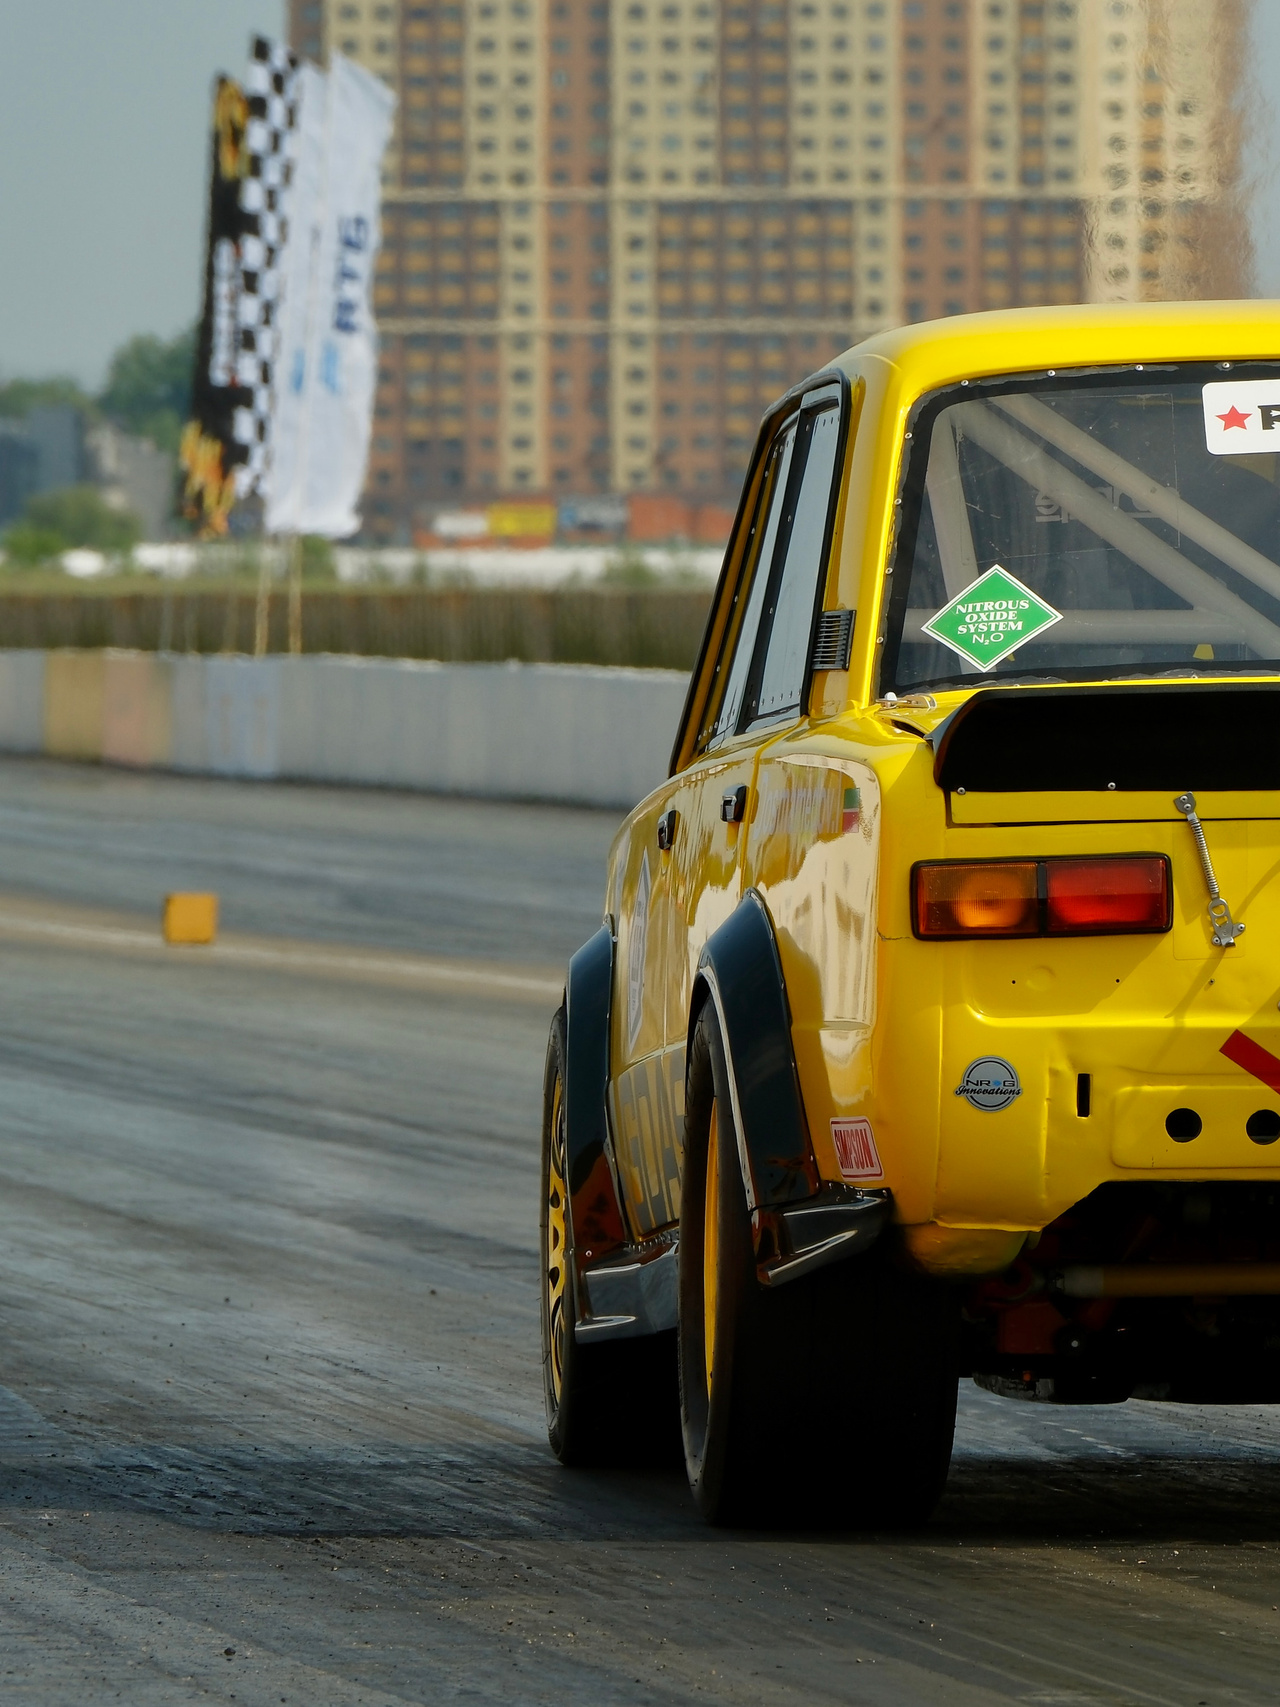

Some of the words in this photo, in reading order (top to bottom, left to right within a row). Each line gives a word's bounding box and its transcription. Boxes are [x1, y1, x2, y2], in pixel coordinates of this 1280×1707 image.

[956, 599, 1030, 615] NITROUS
[964, 610, 1018, 623] OXIDE
[957, 620, 1024, 635] SYSTEM
[955, 1085, 1021, 1096] Innovations
[834, 1128, 875, 1170] SIMPSON
